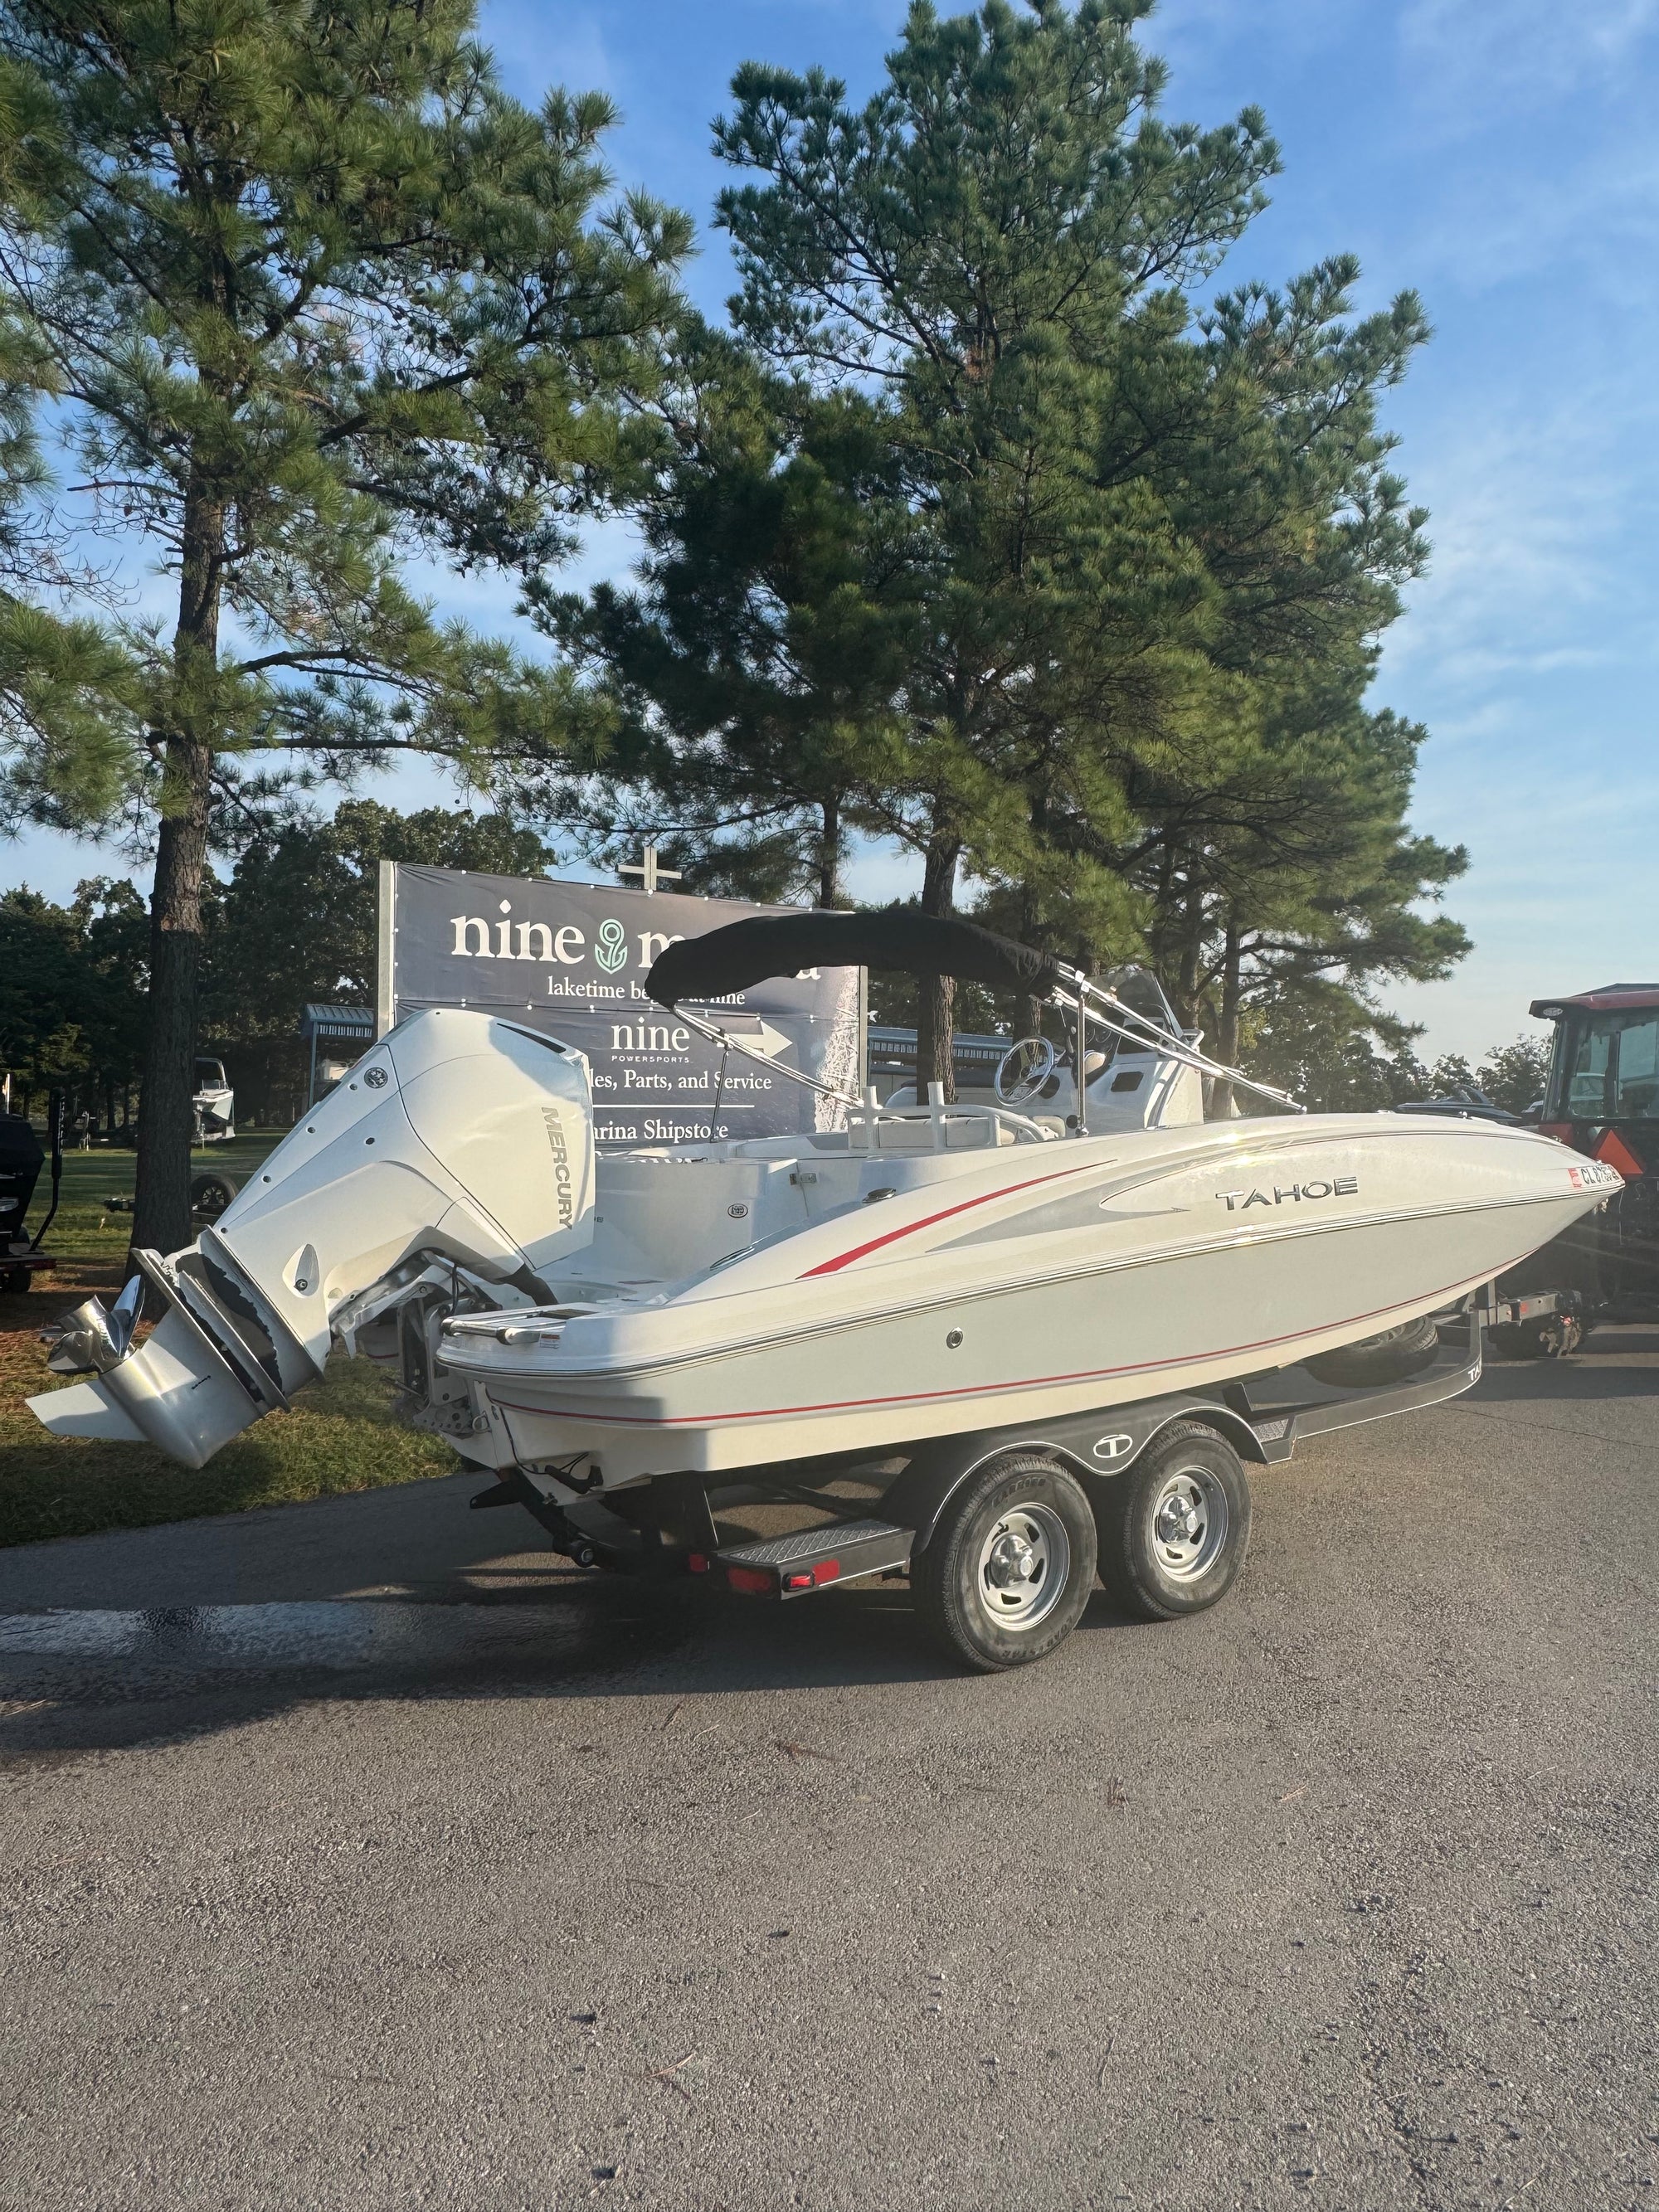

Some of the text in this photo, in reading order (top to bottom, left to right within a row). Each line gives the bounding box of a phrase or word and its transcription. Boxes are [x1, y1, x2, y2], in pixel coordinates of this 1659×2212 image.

[450, 899, 585, 965] nine
[547, 976, 625, 999] laketime
[611, 1016, 690, 1052] nine
[611, 1055, 689, 1063] POWERSPORTS
[590, 1068, 618, 1091] les,
[624, 1069, 672, 1091] Parts,
[678, 1071, 709, 1089] and
[594, 1119, 729, 1144] rina Shipstoe
[542, 1106, 572, 1230] MERCURY
[1215, 1176, 1359, 1211] TAHOE
